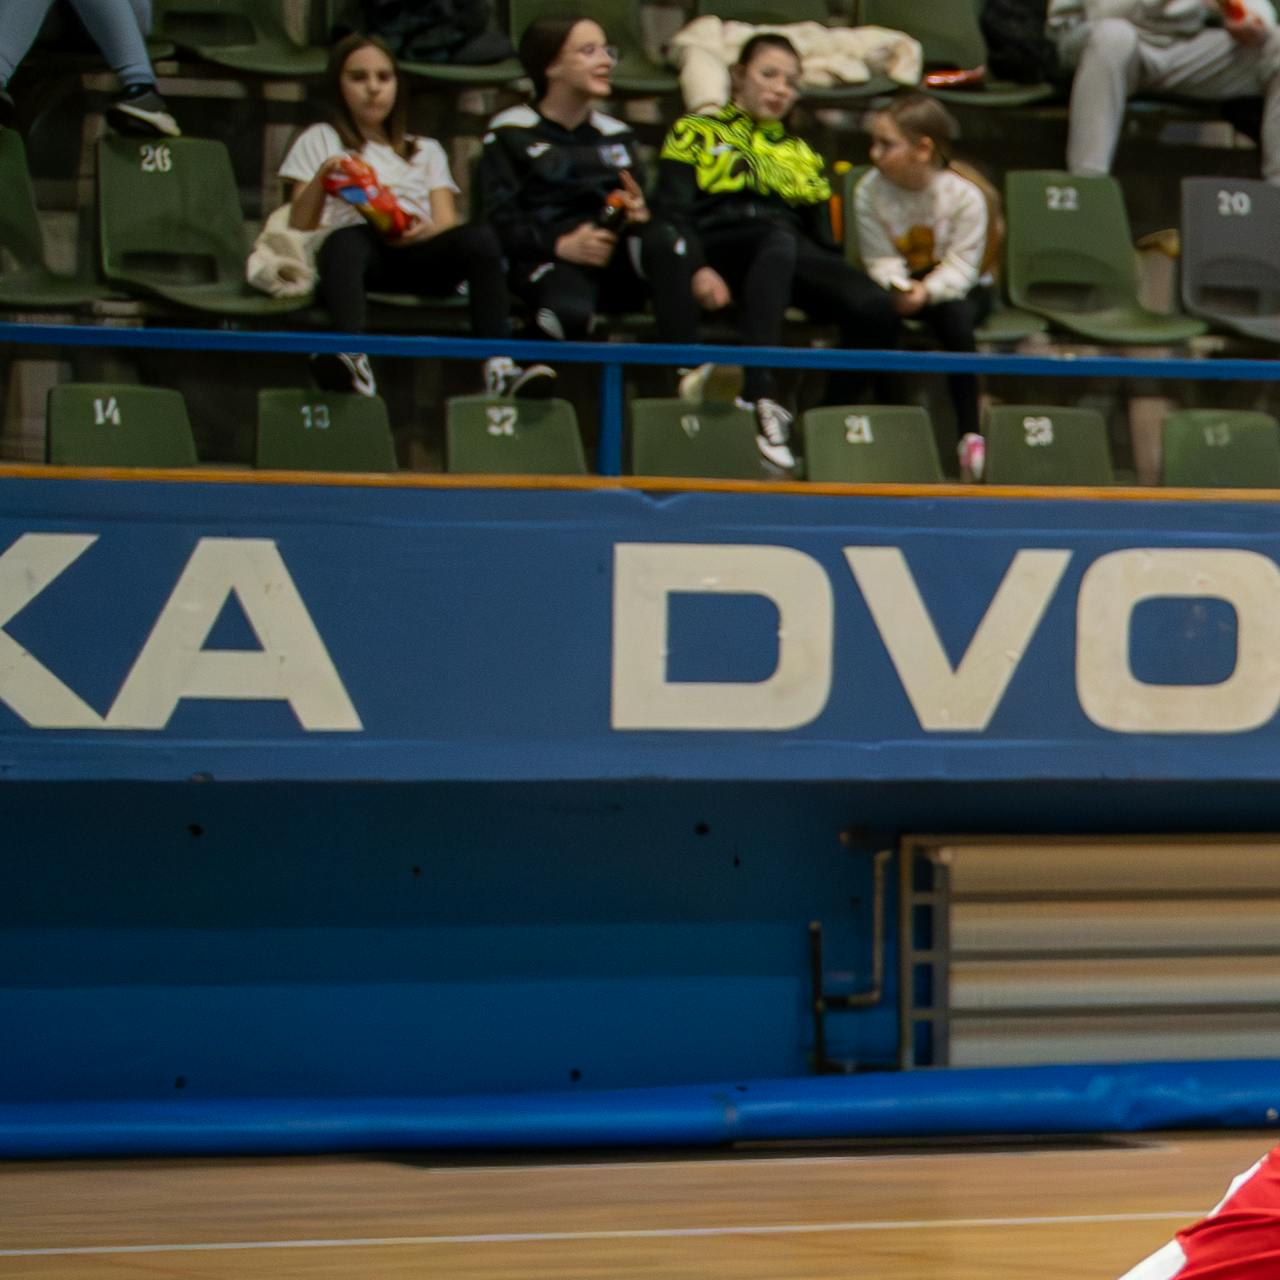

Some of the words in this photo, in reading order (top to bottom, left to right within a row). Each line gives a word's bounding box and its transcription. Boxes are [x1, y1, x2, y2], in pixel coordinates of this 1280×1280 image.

[139, 143, 172, 173] 26
[1217, 188, 1252, 216] 20
[93, 396, 122, 426] 14
